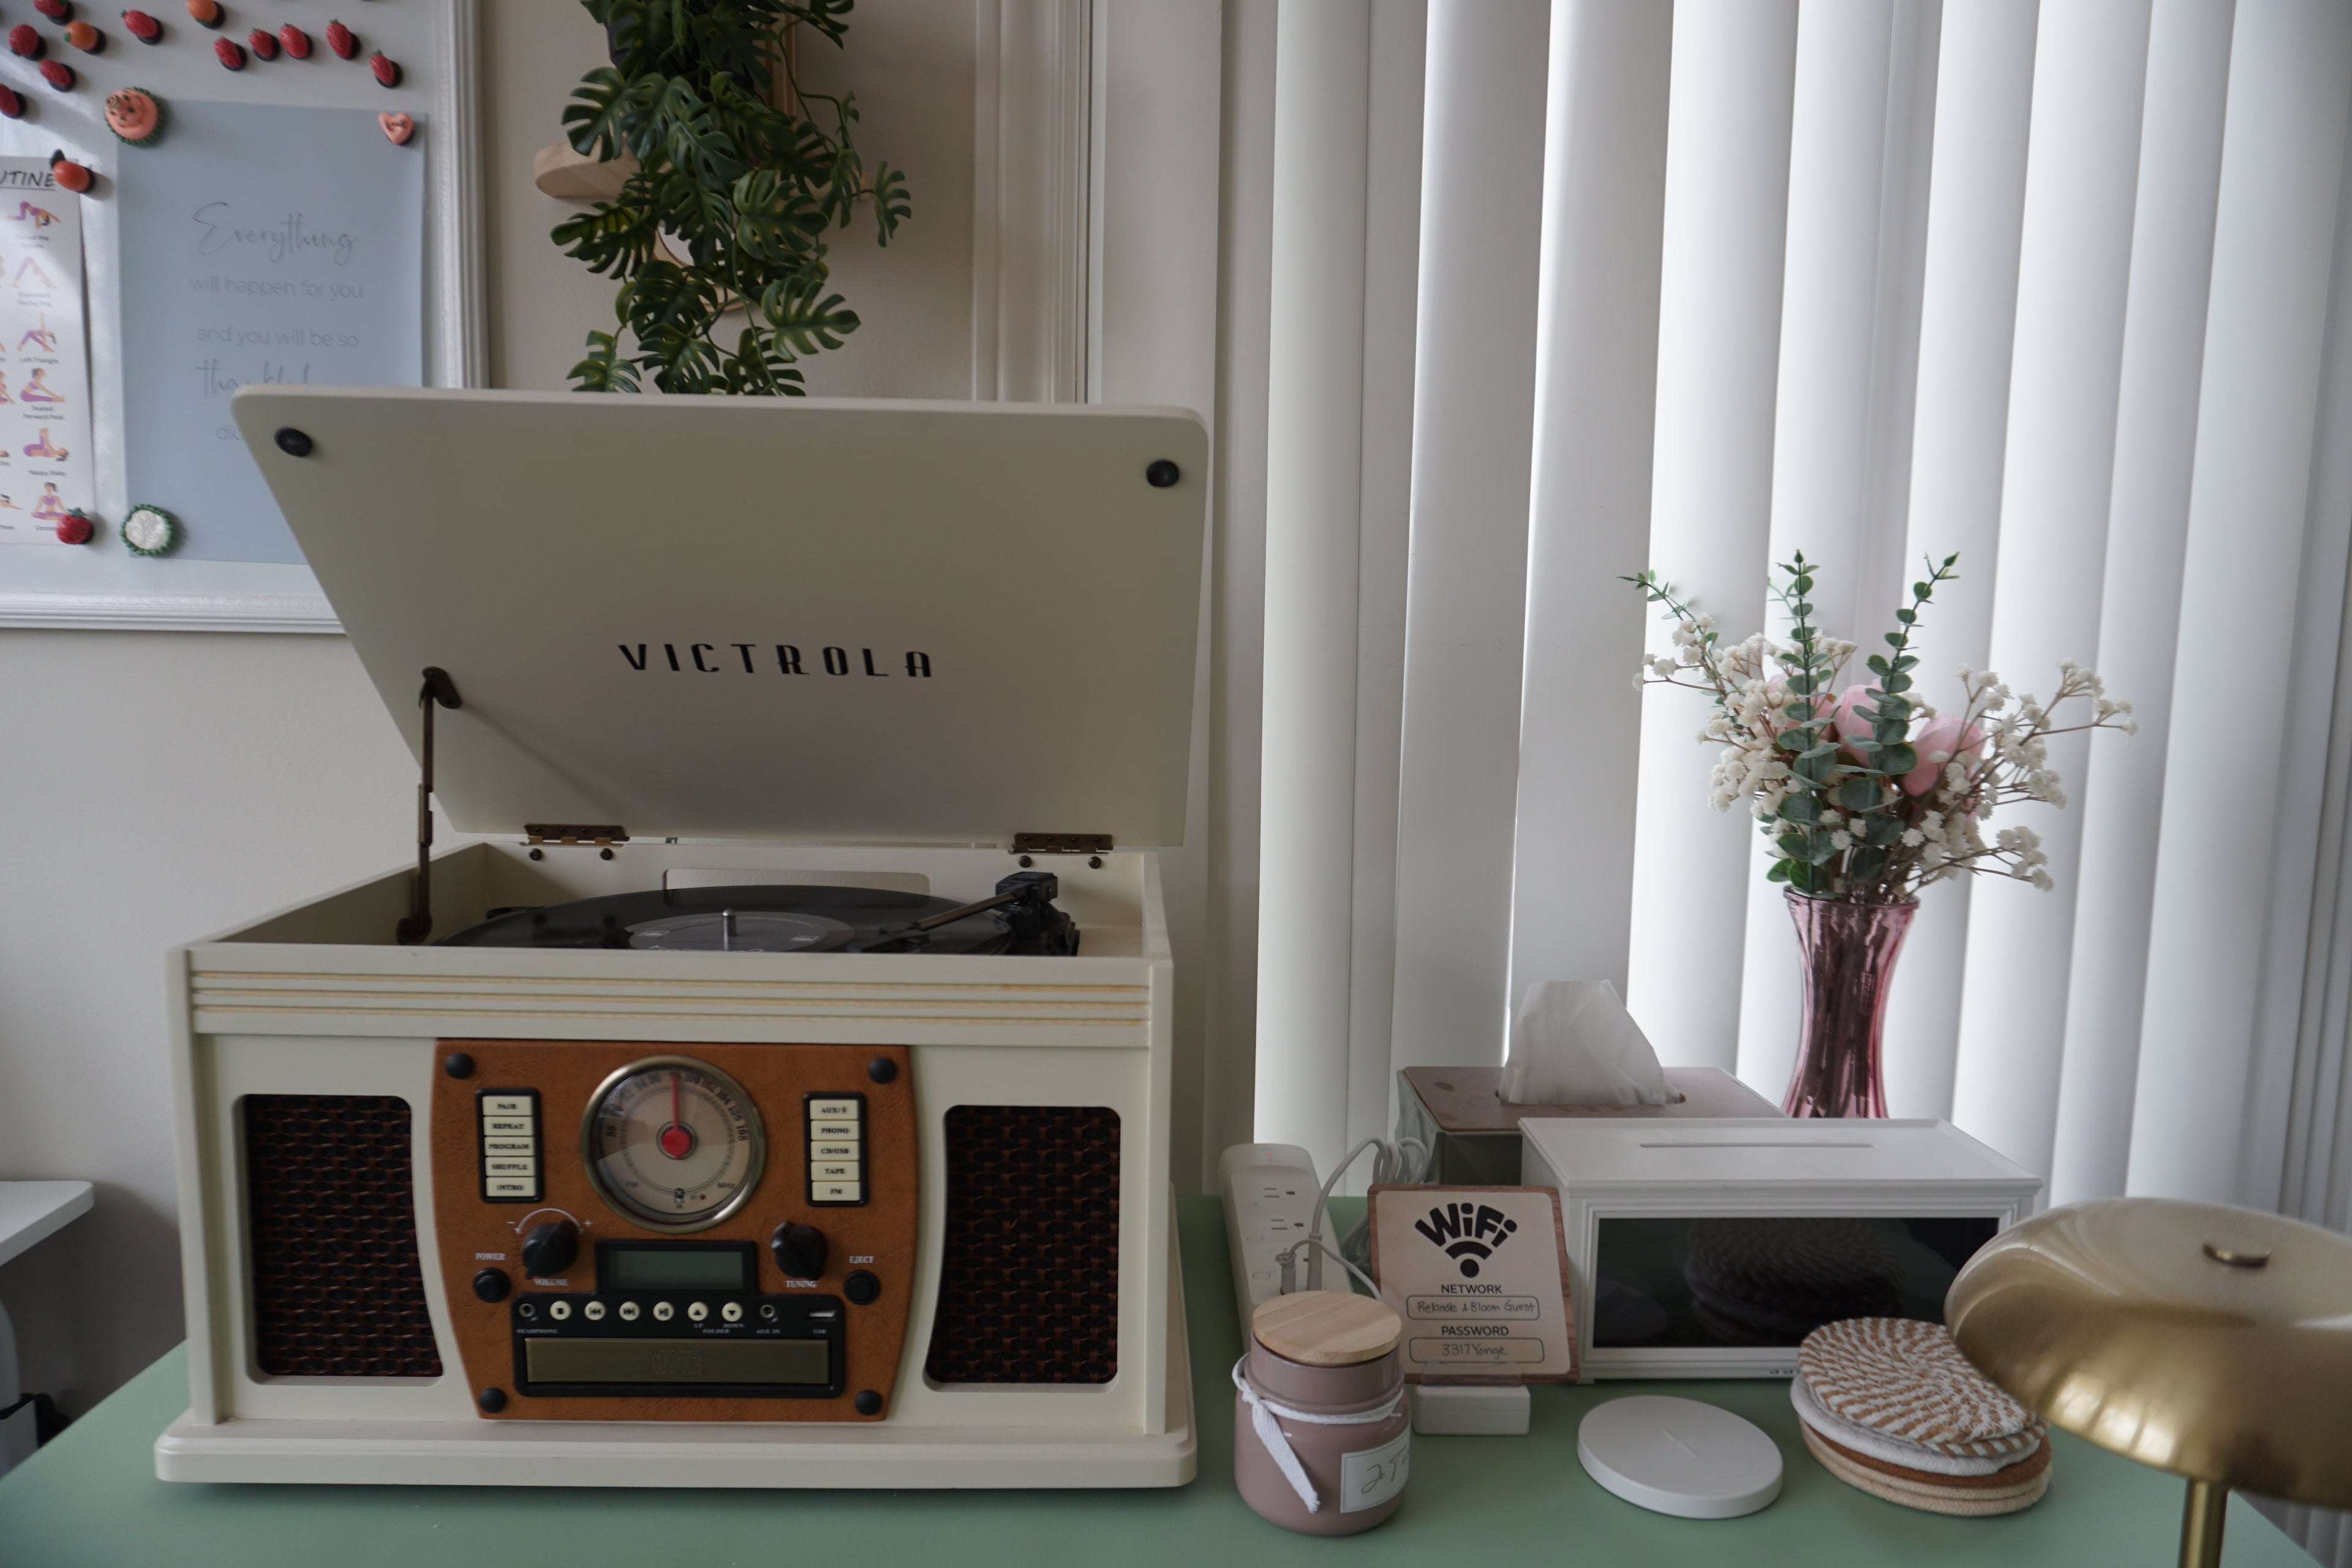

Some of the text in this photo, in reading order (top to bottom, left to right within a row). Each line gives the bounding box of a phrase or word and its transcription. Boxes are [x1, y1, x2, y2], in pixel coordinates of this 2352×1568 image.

[192, 202, 359, 266] Everything
[189, 275, 363, 301] will happen for you
[196, 325, 359, 347] and you will be so
[617, 643, 932, 678] VICTROLA
[701, 1077, 717, 1093] 102
[716, 1090, 731, 1106] 104
[728, 1103, 741, 1121] 106
[736, 1125, 748, 1141] 108
[1414, 1202, 1517, 1248] WiFi
[1441, 1284, 1502, 1294] NETWORK
[1417, 1300, 1458, 1313] Rekindle
[1470, 1302, 1501, 1313] Bloom
[1504, 1299, 1536, 1313] Guest
[1441, 1326, 1509, 1336] PASSWORD
